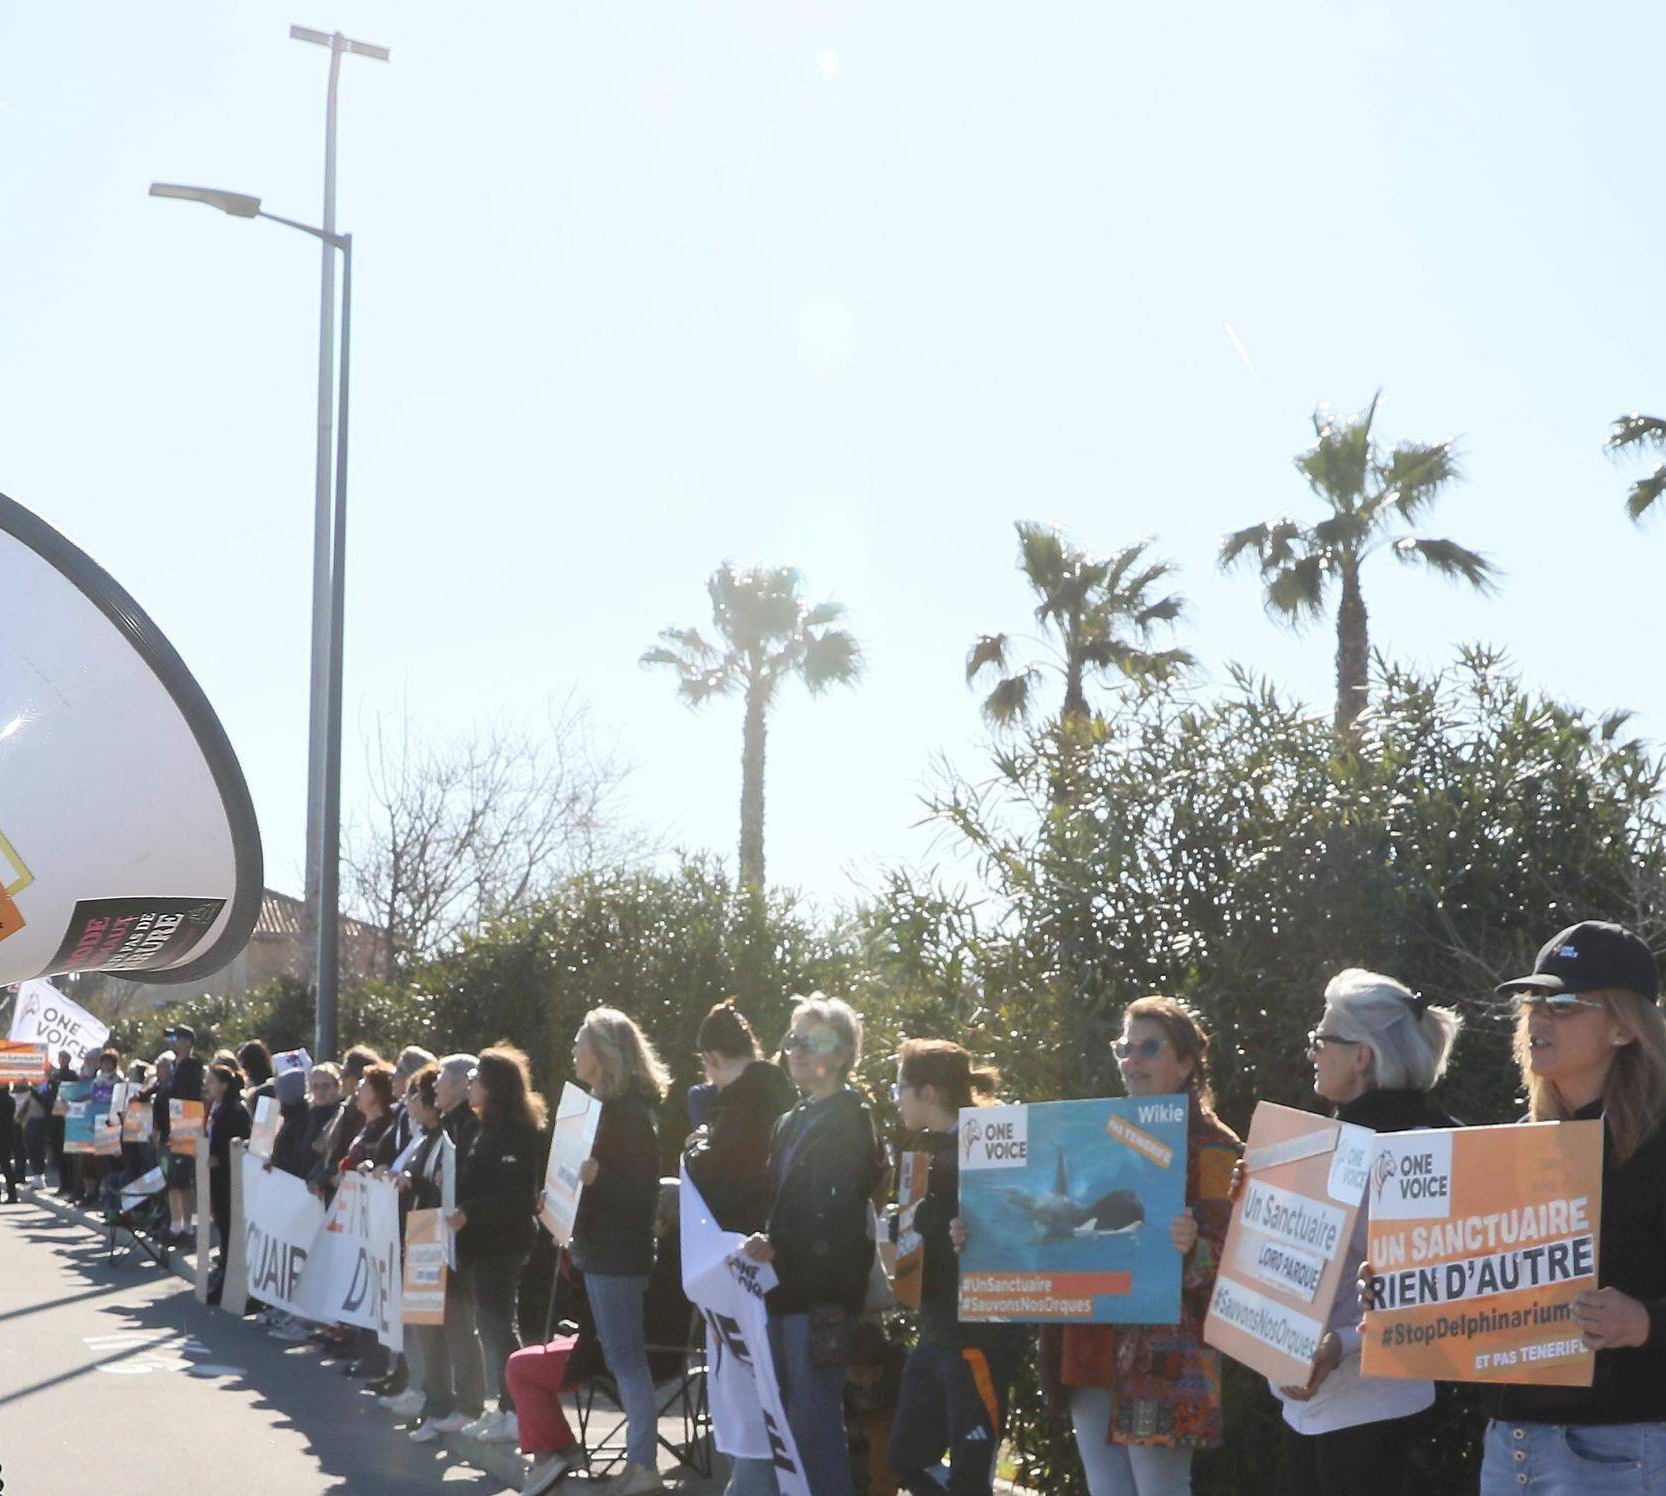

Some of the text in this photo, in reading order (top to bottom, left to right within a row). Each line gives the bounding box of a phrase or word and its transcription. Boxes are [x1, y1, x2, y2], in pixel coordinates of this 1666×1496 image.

[135, 911, 157, 931] DE
[43, 1008, 83, 1035] ONE
[1138, 1104, 1183, 1123] Wikie
[985, 1123, 1013, 1140] ONE
[985, 1142, 1027, 1159] VOICE
[1400, 1153, 1433, 1177] ONE
[1400, 1176, 1448, 1200] VOICE
[1244, 1184, 1338, 1250] Un Sanctuaire
[1373, 1196, 1590, 1268] UN SANCTUAIRE
[1282, 1249, 1321, 1291] PARQUE
[1371, 1236, 1594, 1312] RIEN D'AUTRE
[962, 1275, 1052, 1292] #UnSanctuaire
[962, 1296, 1091, 1316] #SauvonsNosOrques
[1213, 1288, 1316, 1361] #SauvonsNosOrques
[1382, 1301, 1573, 1347] #StopDelphinarium
[1475, 1355, 1490, 1370] ET
[1493, 1350, 1518, 1366] PAS
